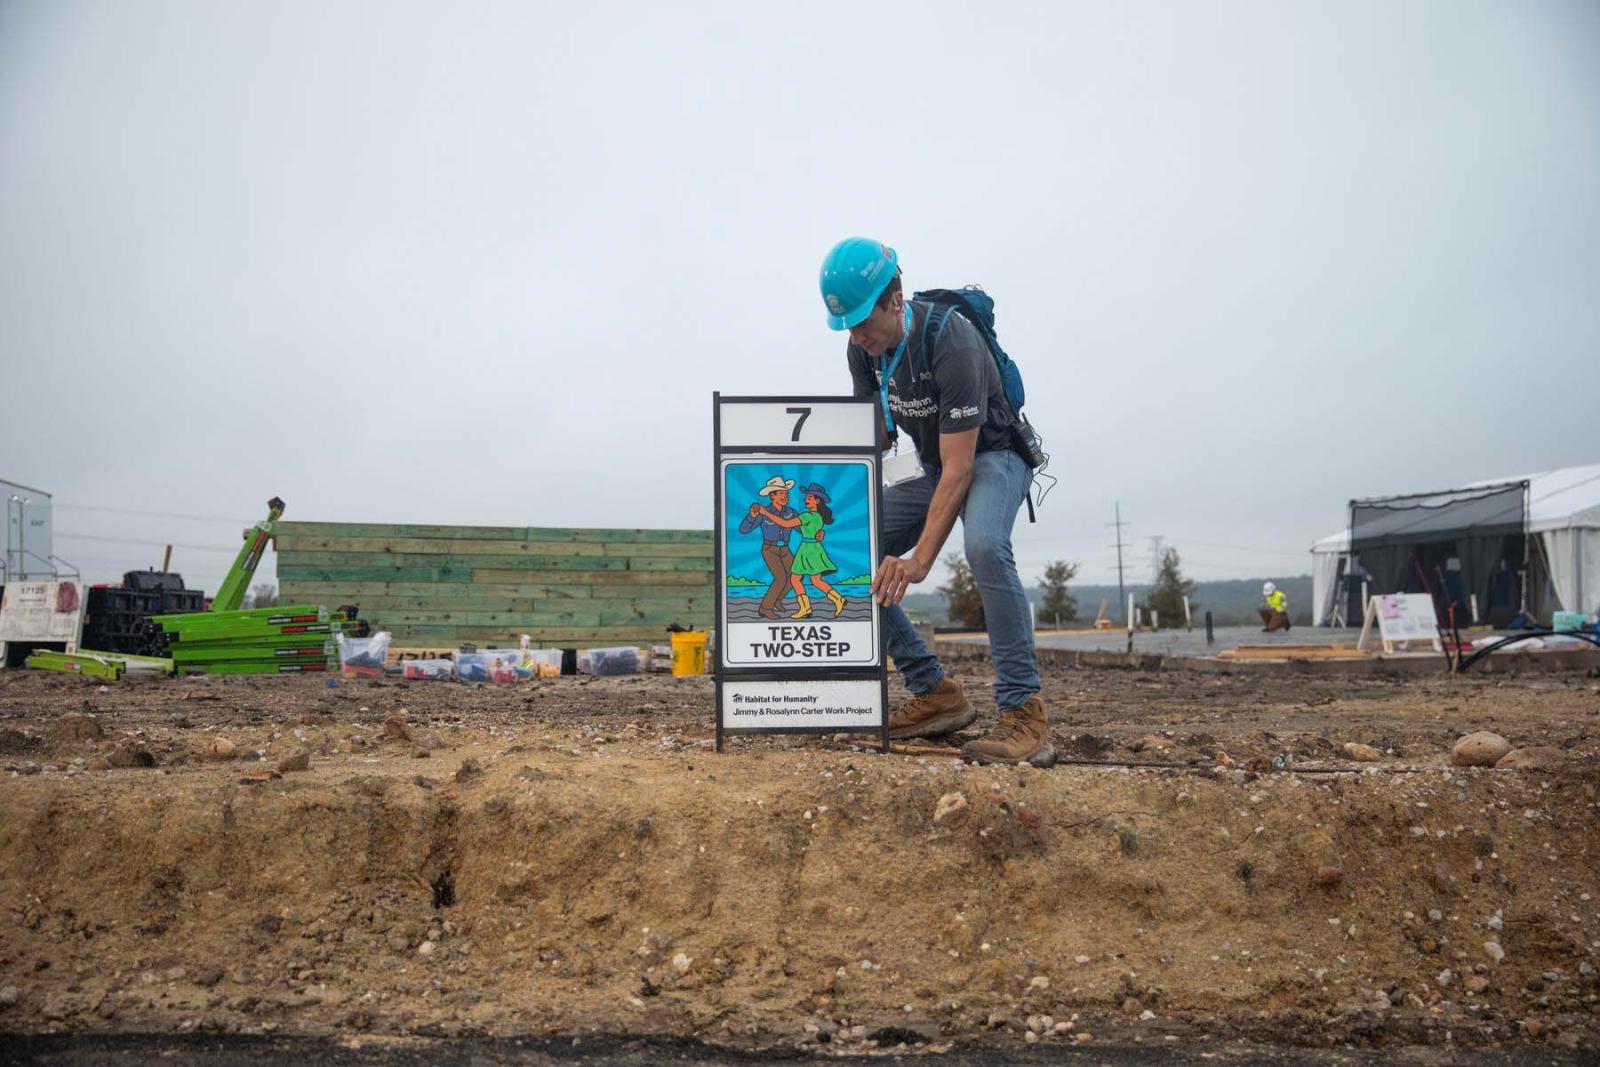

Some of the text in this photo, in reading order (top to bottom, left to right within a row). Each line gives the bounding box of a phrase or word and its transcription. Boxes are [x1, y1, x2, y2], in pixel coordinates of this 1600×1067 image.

[786, 407, 811, 442] 7
[768, 625, 832, 641] TEXAS
[750, 642, 851, 658] TWO-STEP
[744, 695, 817, 704] Habitat for Humanity
[732, 706, 873, 717] Jimmy & Rosalynn Carter Work Project
